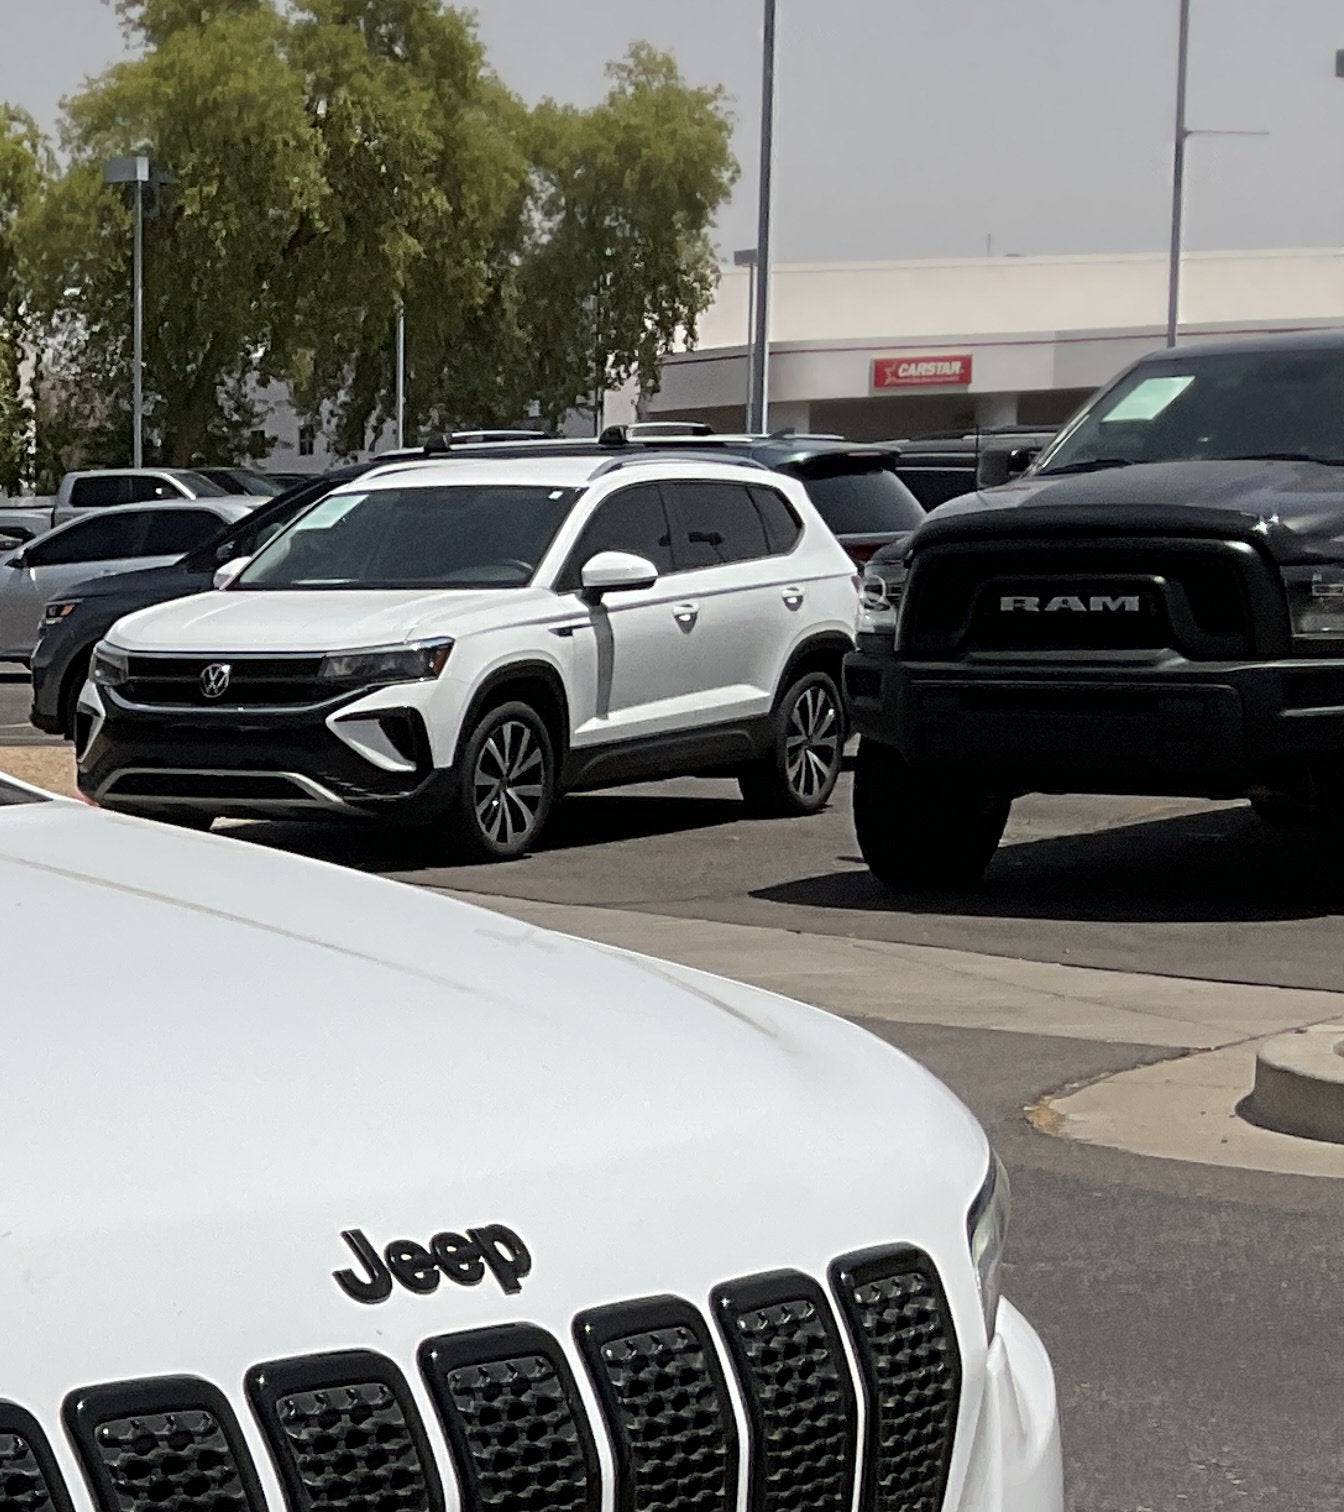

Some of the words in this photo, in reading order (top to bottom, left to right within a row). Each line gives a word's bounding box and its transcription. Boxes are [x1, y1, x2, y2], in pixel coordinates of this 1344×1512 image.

[898, 361, 962, 378] CARSTAR
[1000, 595, 1140, 612] RAM
[332, 1223, 532, 1305] Jeep
